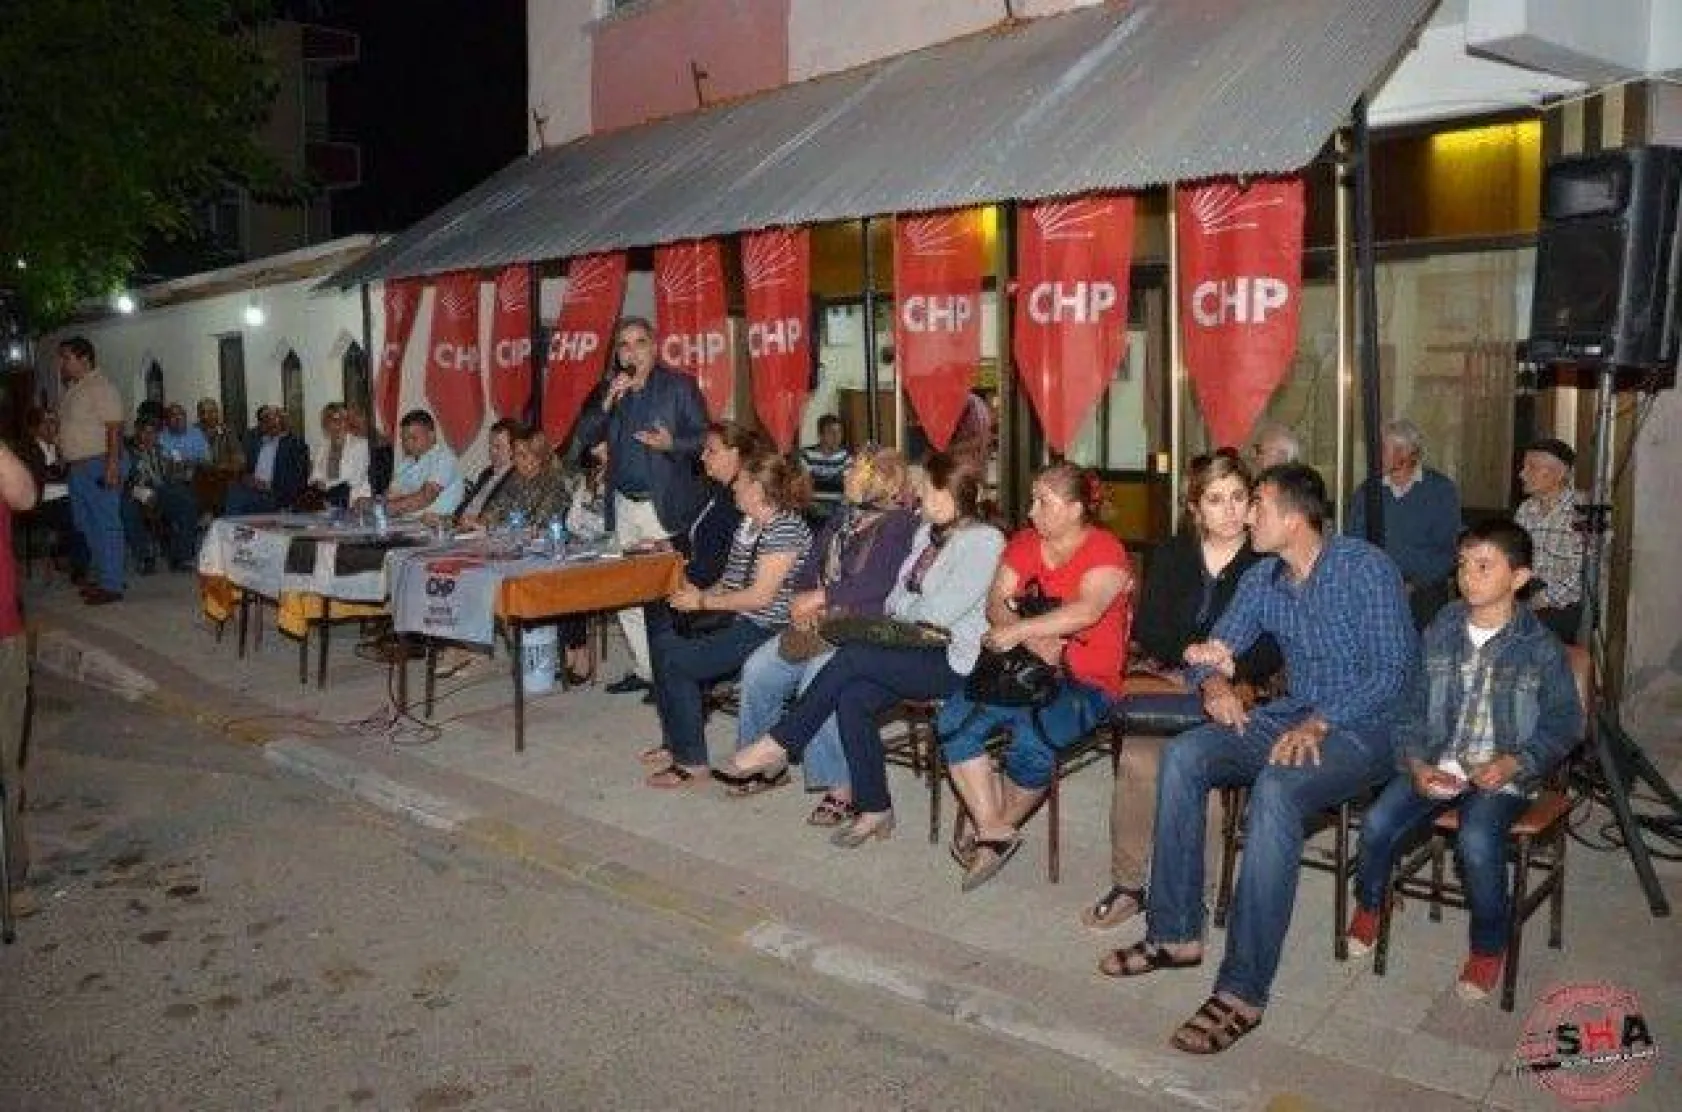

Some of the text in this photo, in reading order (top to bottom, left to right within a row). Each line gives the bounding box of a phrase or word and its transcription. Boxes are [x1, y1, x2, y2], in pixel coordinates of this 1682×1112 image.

[904, 296, 971, 332] CHP
[1029, 281, 1117, 324] CHP
[1192, 276, 1288, 326] CHP
[661, 333, 725, 366] CHP
[749, 318, 802, 357] CHP
[434, 342, 480, 371] CH
